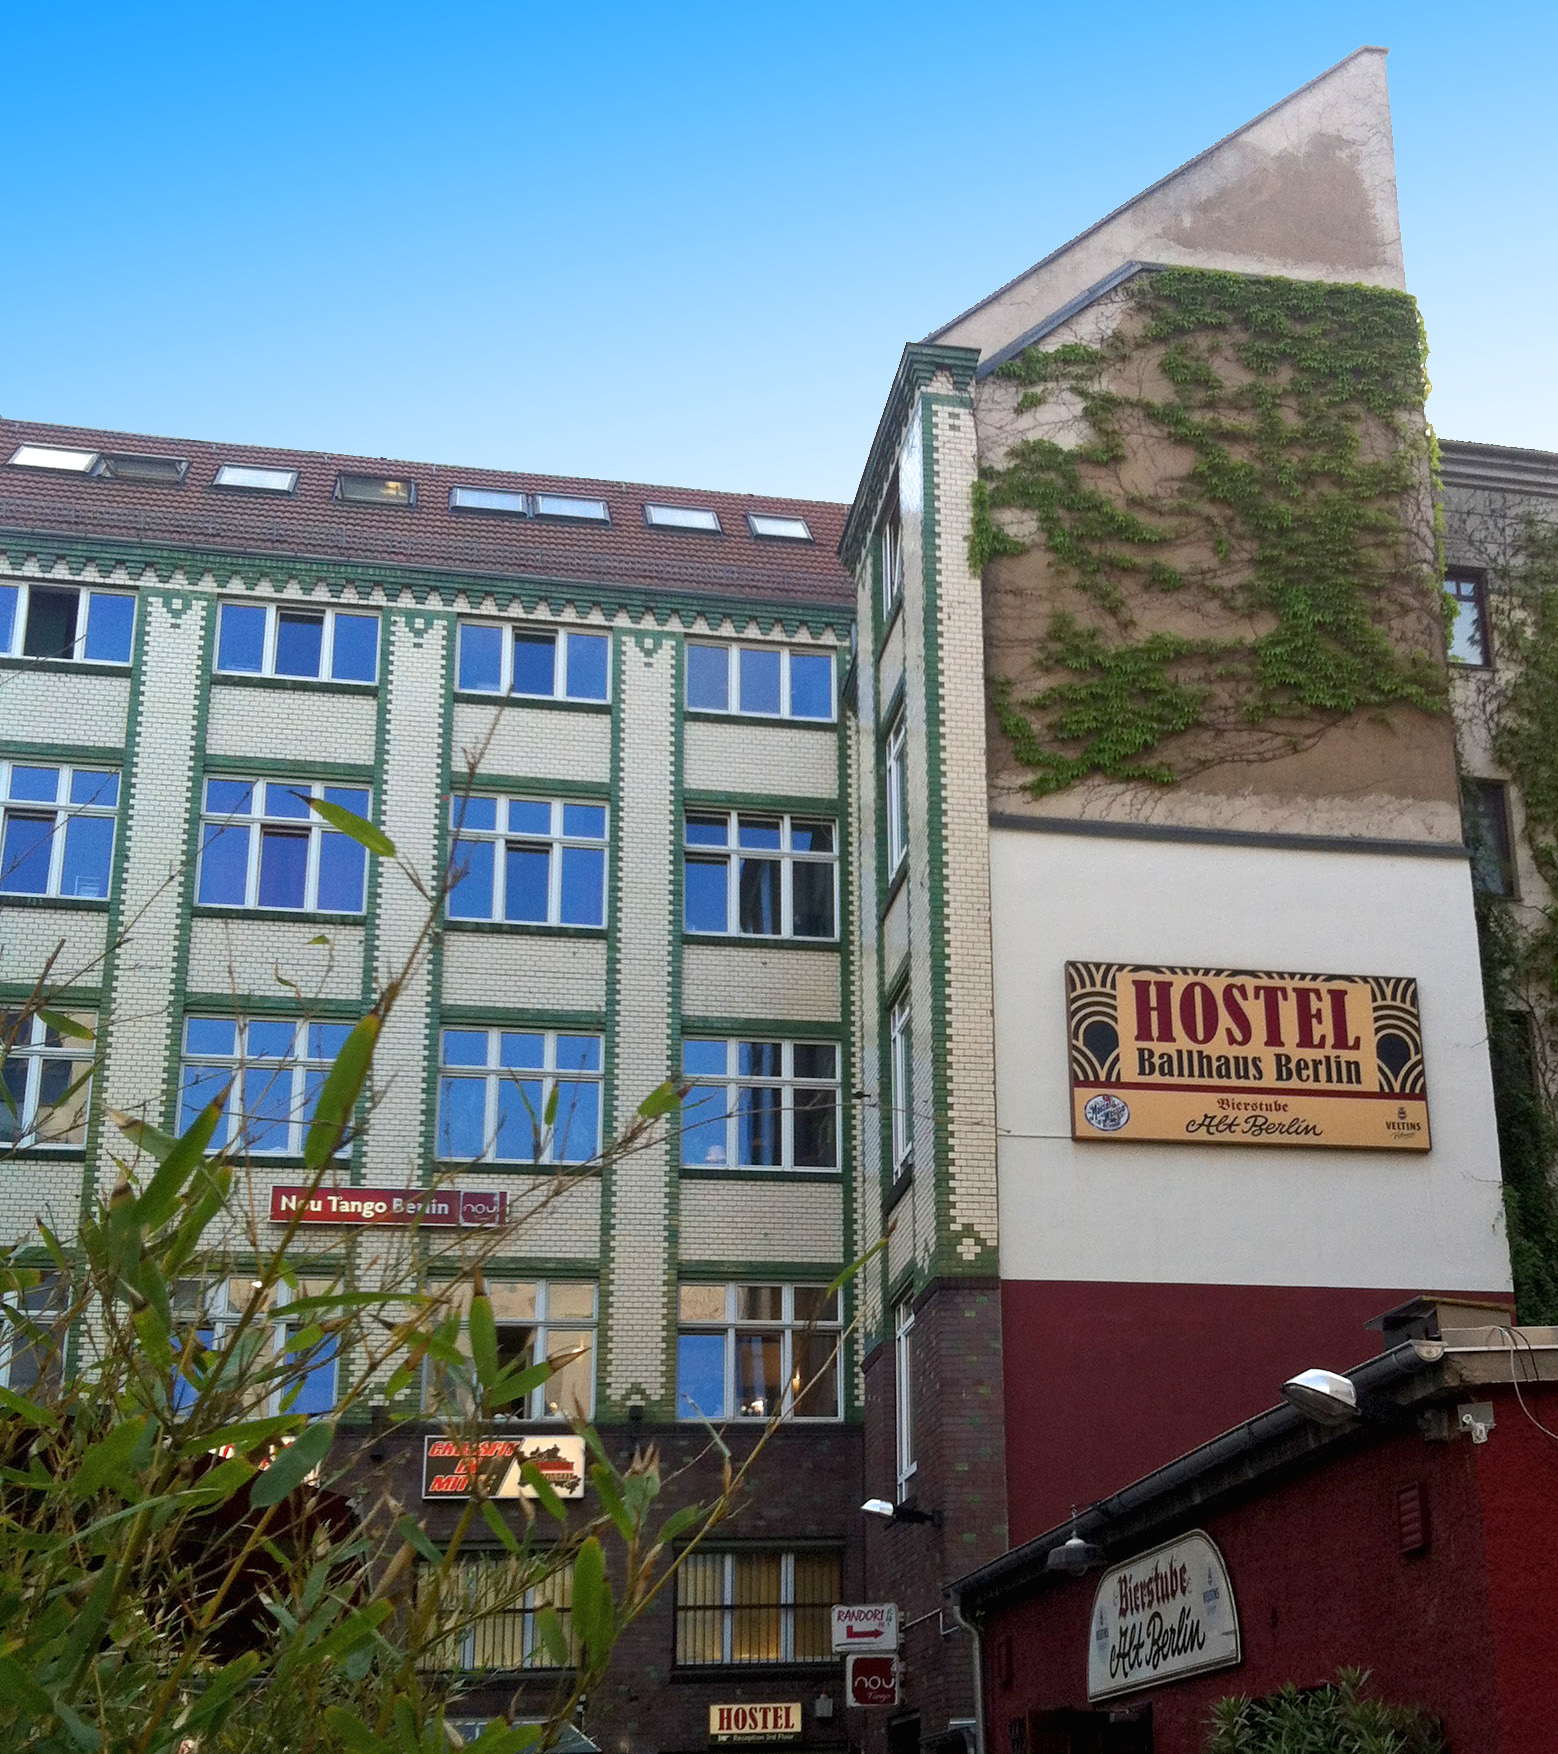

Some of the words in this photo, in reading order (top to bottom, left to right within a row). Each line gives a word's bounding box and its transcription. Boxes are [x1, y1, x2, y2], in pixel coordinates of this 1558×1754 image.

[1131, 979, 1361, 1051] HOSTEL
[1136, 1047, 1264, 1082] Ballhaus
[1274, 1053, 1362, 1085] Berlin
[1216, 1097, 1289, 1113] Bierstube
[1185, 1113, 1241, 1135] Alt
[1241, 1114, 1323, 1137] Berlin
[1384, 1121, 1422, 1131] VELTINS
[327, 1195, 387, 1218] Tango
[392, 1197, 449, 1215] Bein
[1117, 1554, 1190, 1620] Bierstube
[837, 1609, 884, 1622] RANDORI
[1109, 1622, 1145, 1679] Alt
[1145, 1605, 1206, 1670] Berlin
[854, 1675, 895, 1690] nou
[718, 1706, 795, 1731] HOSTEL
